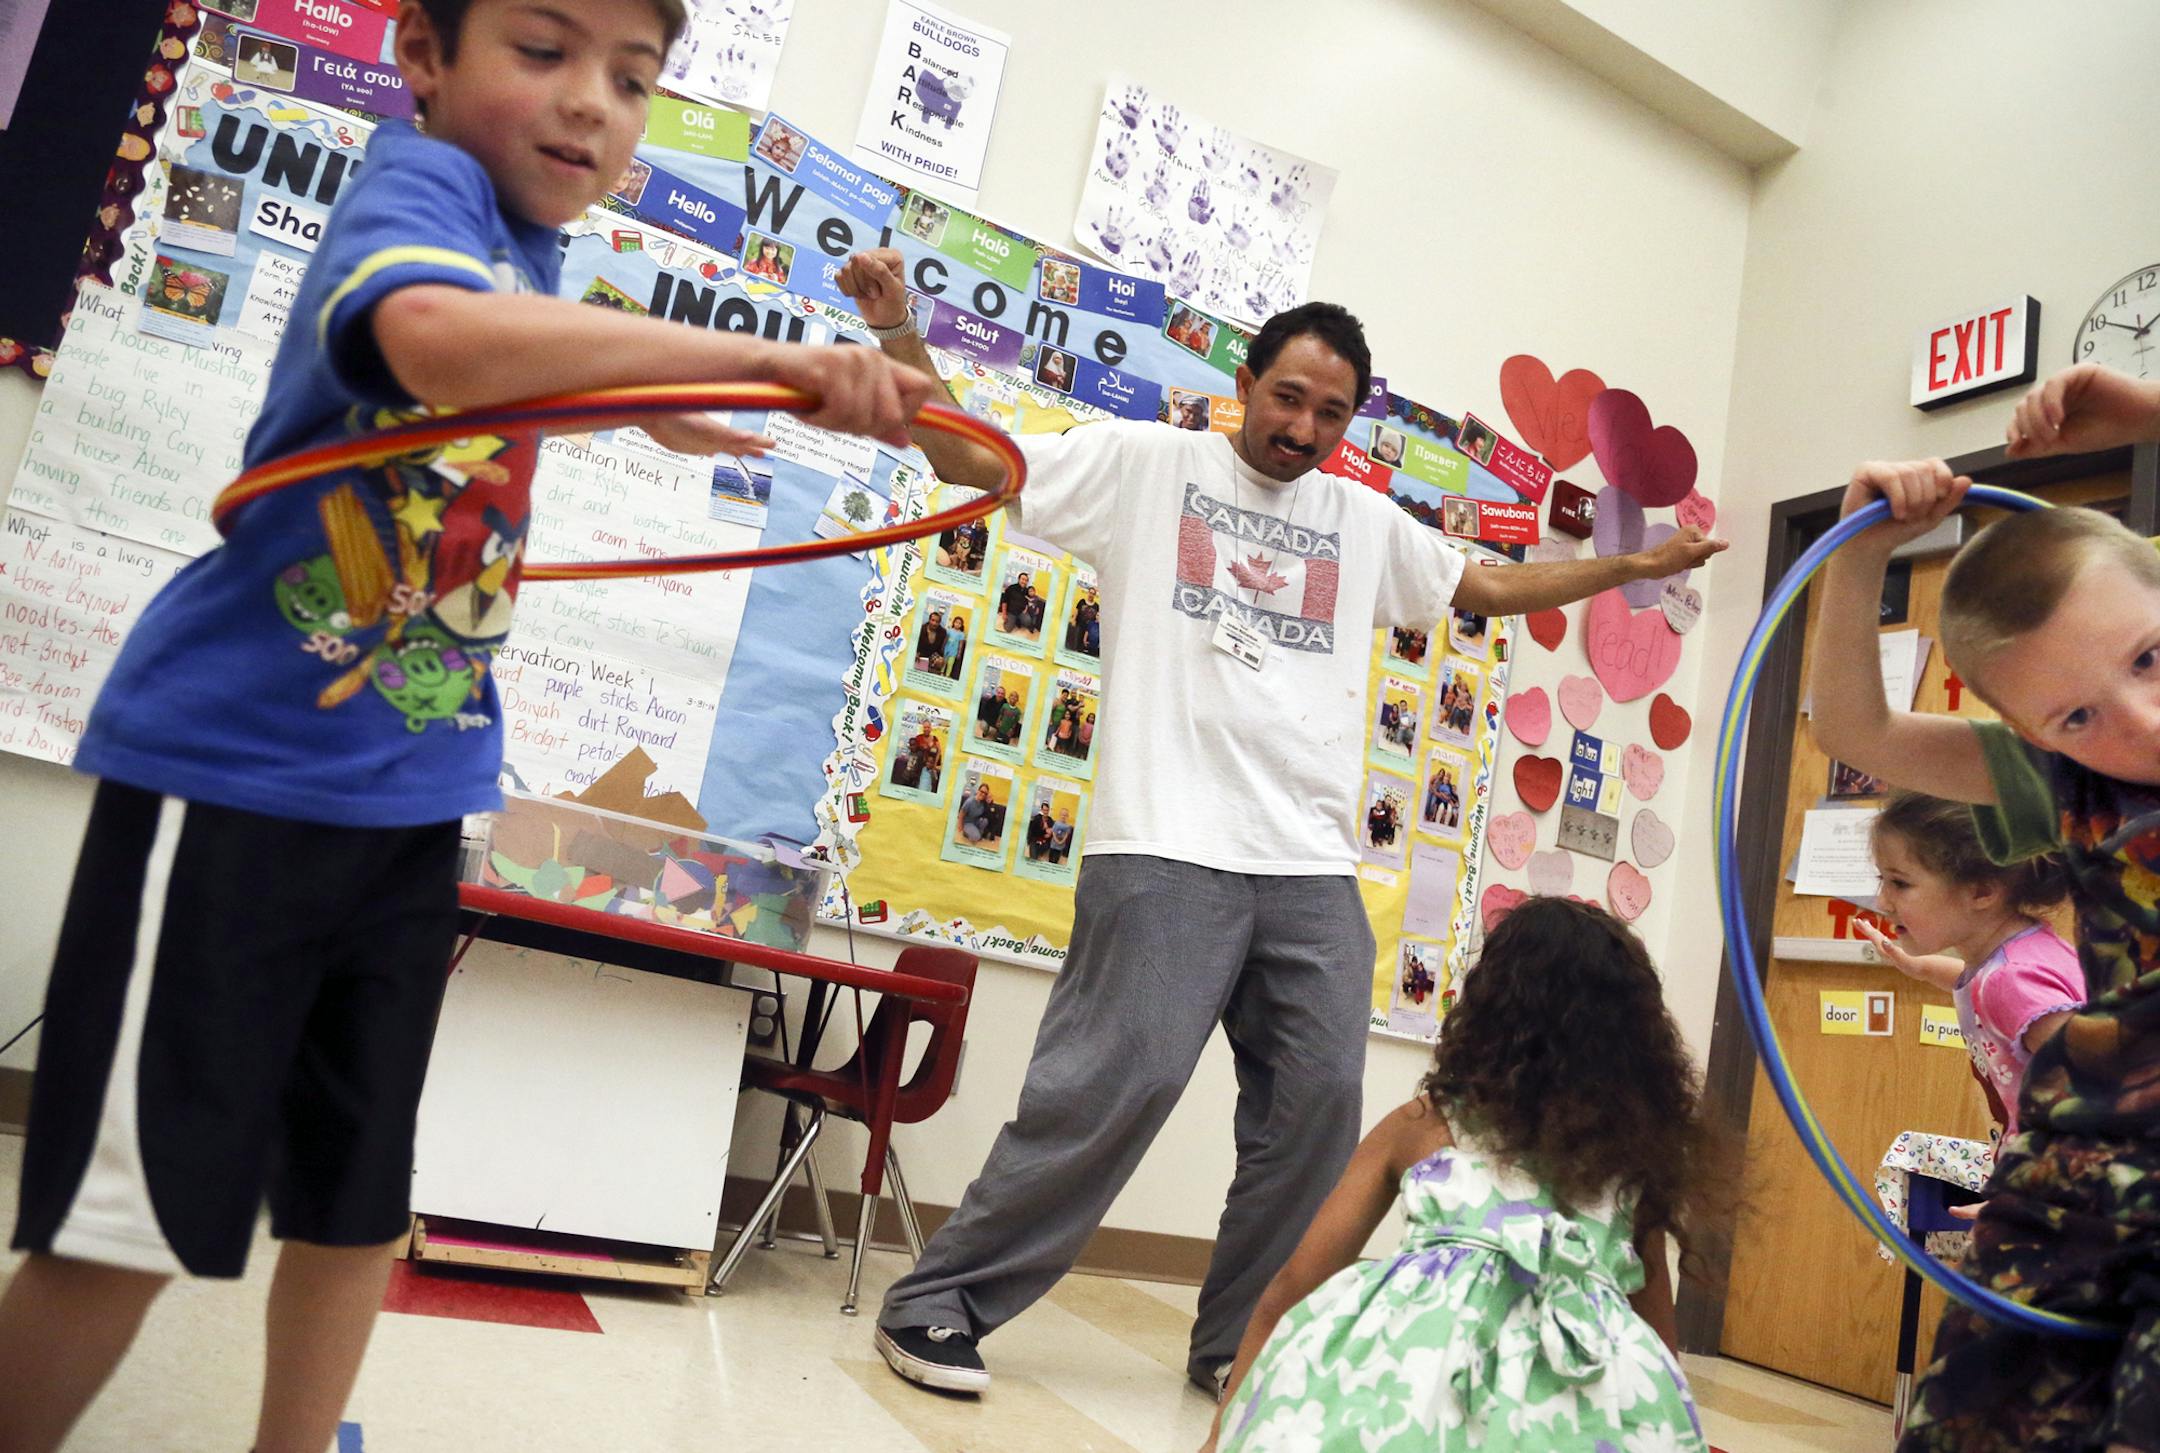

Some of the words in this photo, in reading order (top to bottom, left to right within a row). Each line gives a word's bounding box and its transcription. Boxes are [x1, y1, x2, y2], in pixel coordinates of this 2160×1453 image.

[294, 0, 353, 28] Hallo
[920, 16, 945, 33] EARLE
[947, 29, 977, 45] BROWN
[912, 21, 980, 57] BULLDOGS
[313, 56, 358, 80] Γειά
[364, 71, 403, 89] σου
[682, 109, 716, 130] Olá
[211, 113, 362, 206] UNI
[807, 145, 862, 187] Selamat
[861, 181, 894, 206] pagi
[881, 140, 912, 163] WITH
[914, 156, 958, 179] PRIDE!
[256, 200, 322, 243] Sha
[667, 189, 716, 224] Hello
[120, 243, 148, 297] Back!
[272, 258, 294, 274] Key
[2136, 271, 2158, 293] 12
[1108, 277, 1137, 298] Hoi
[2112, 289, 2128, 309] 11
[78, 290, 126, 323] What
[211, 341, 242, 364] ving
[824, 306, 868, 331] Welco
[955, 315, 1000, 345] Salut
[2089, 313, 2107, 333] 10
[70, 316, 85, 333] a
[109, 326, 169, 360] house
[1226, 339, 1248, 360] Alo
[1928, 307, 2013, 392] EXIT
[2083, 341, 2095, 359] 9
[57, 343, 111, 370] people
[132, 358, 159, 384] live
[184, 380, 204, 399] in
[1097, 370, 1136, 395] سلام
[52, 372, 65, 386] a
[87, 376, 127, 409] bug
[993, 371, 1051, 400] Welcome
[1056, 392, 1096, 416] Back!
[31, 430, 45, 445] a
[40, 400, 54, 415] a
[76, 402, 151, 450] building
[167, 430, 205, 467] Cory
[628, 428, 648, 440] What
[539, 434, 618, 472] servation
[624, 457, 664, 488] Week
[794, 443, 806, 451] can
[807, 445, 828, 459] impact
[829, 454, 846, 468] living
[1340, 446, 1372, 475] Hola
[1414, 444, 1459, 471] Привет
[1497, 445, 1547, 486] こんにちは
[23, 450, 81, 495] having
[547, 484, 576, 504] dirt
[583, 500, 611, 516] and
[1480, 503, 1536, 521] Sawubona
[1561, 506, 1577, 519] FIRE
[591, 528, 628, 549] acorn
[1188, 490, 1341, 558] CANADA
[7, 513, 52, 543] What
[71, 537, 85, 552] is
[96, 546, 108, 558] a
[117, 548, 154, 577] living
[890, 552, 913, 618] Welcome
[607, 613, 647, 639] sticks
[1178, 586, 1332, 649] CANADA
[853, 620, 876, 689] Welcome
[591, 660, 635, 690] Week
[544, 677, 584, 700] purple
[599, 688, 639, 712] sticks
[645, 696, 687, 725] Aaron
[578, 708, 609, 733] dirt
[615, 715, 677, 750] Raynard
[841, 697, 861, 744] Back!
[1471, 803, 1485, 858] Welcome
[1464, 865, 1477, 905] Back!
[982, 934, 1026, 954] Back!
[1825, 1004, 1857, 1021] door
[1923, 1018, 1934, 1033] la
[1938, 1024, 1964, 1040] pue
